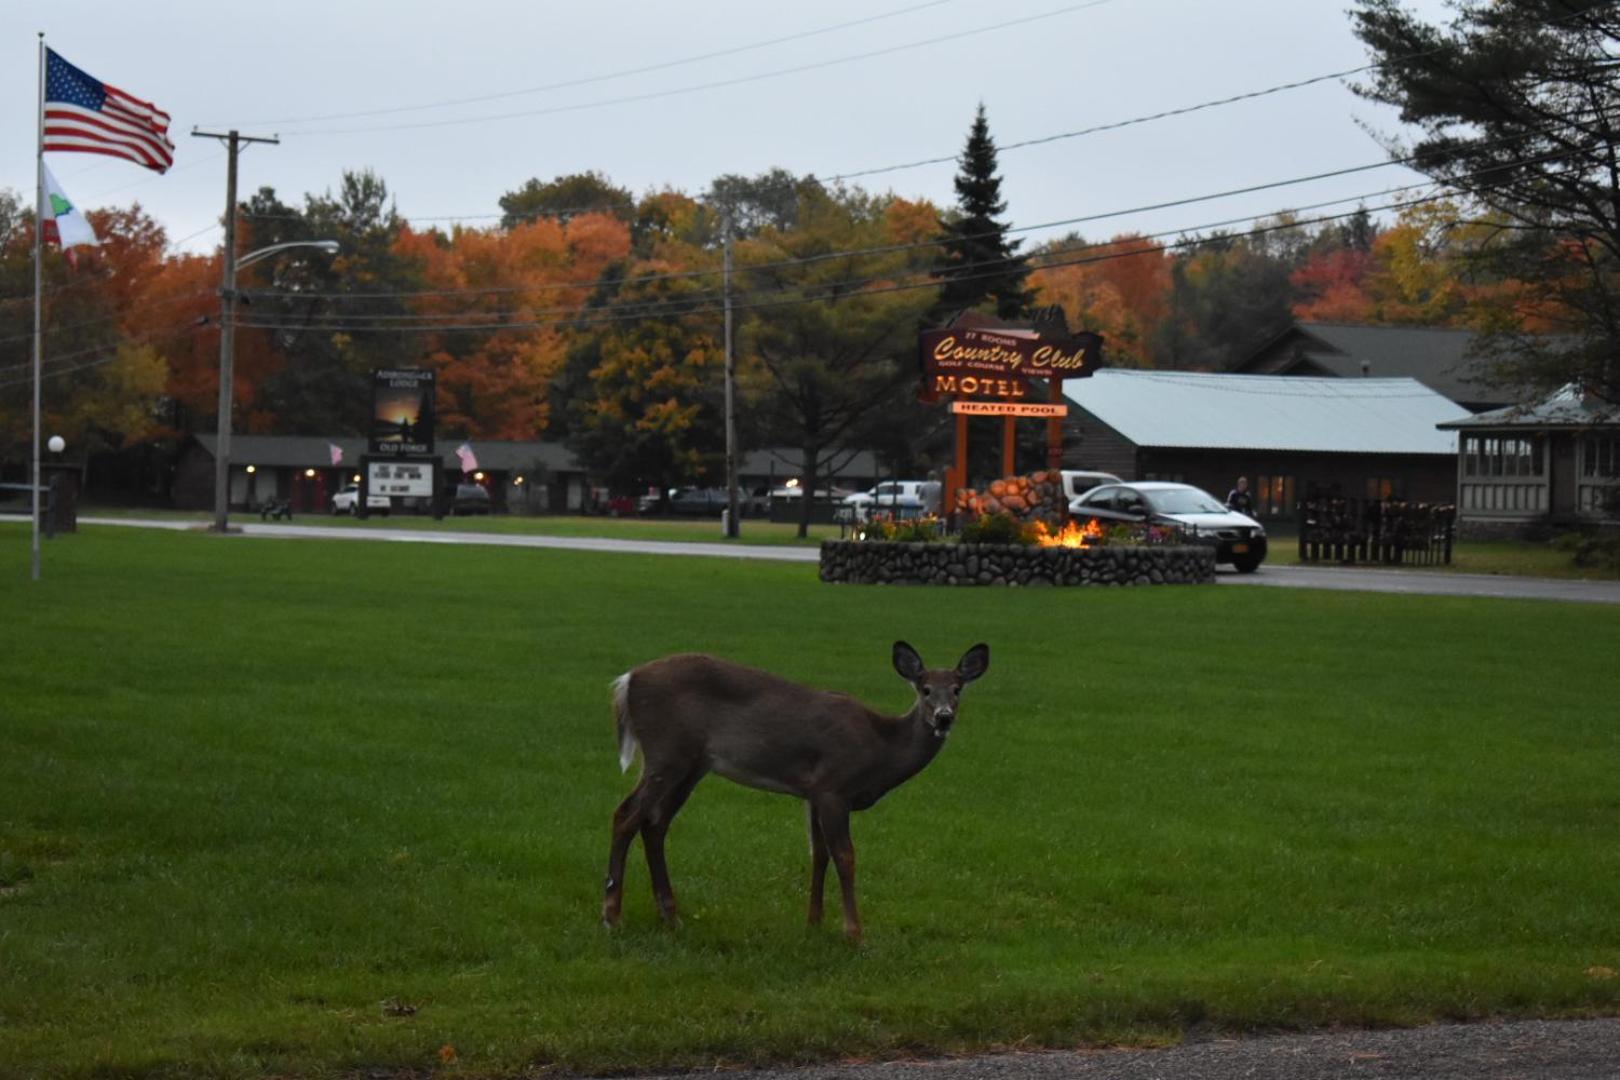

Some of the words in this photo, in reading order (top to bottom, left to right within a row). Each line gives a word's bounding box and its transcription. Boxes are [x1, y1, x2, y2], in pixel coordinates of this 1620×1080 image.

[981, 334, 1016, 346] ROOMS
[934, 336, 1022, 368] Country
[1032, 346, 1085, 368] Club
[966, 361, 1005, 372] COURSE
[935, 375, 1025, 397] MOTEL
[961, 404, 1016, 413] HEATED
[1020, 406, 1058, 415] POOL
[379, 443, 398, 452] OLD
